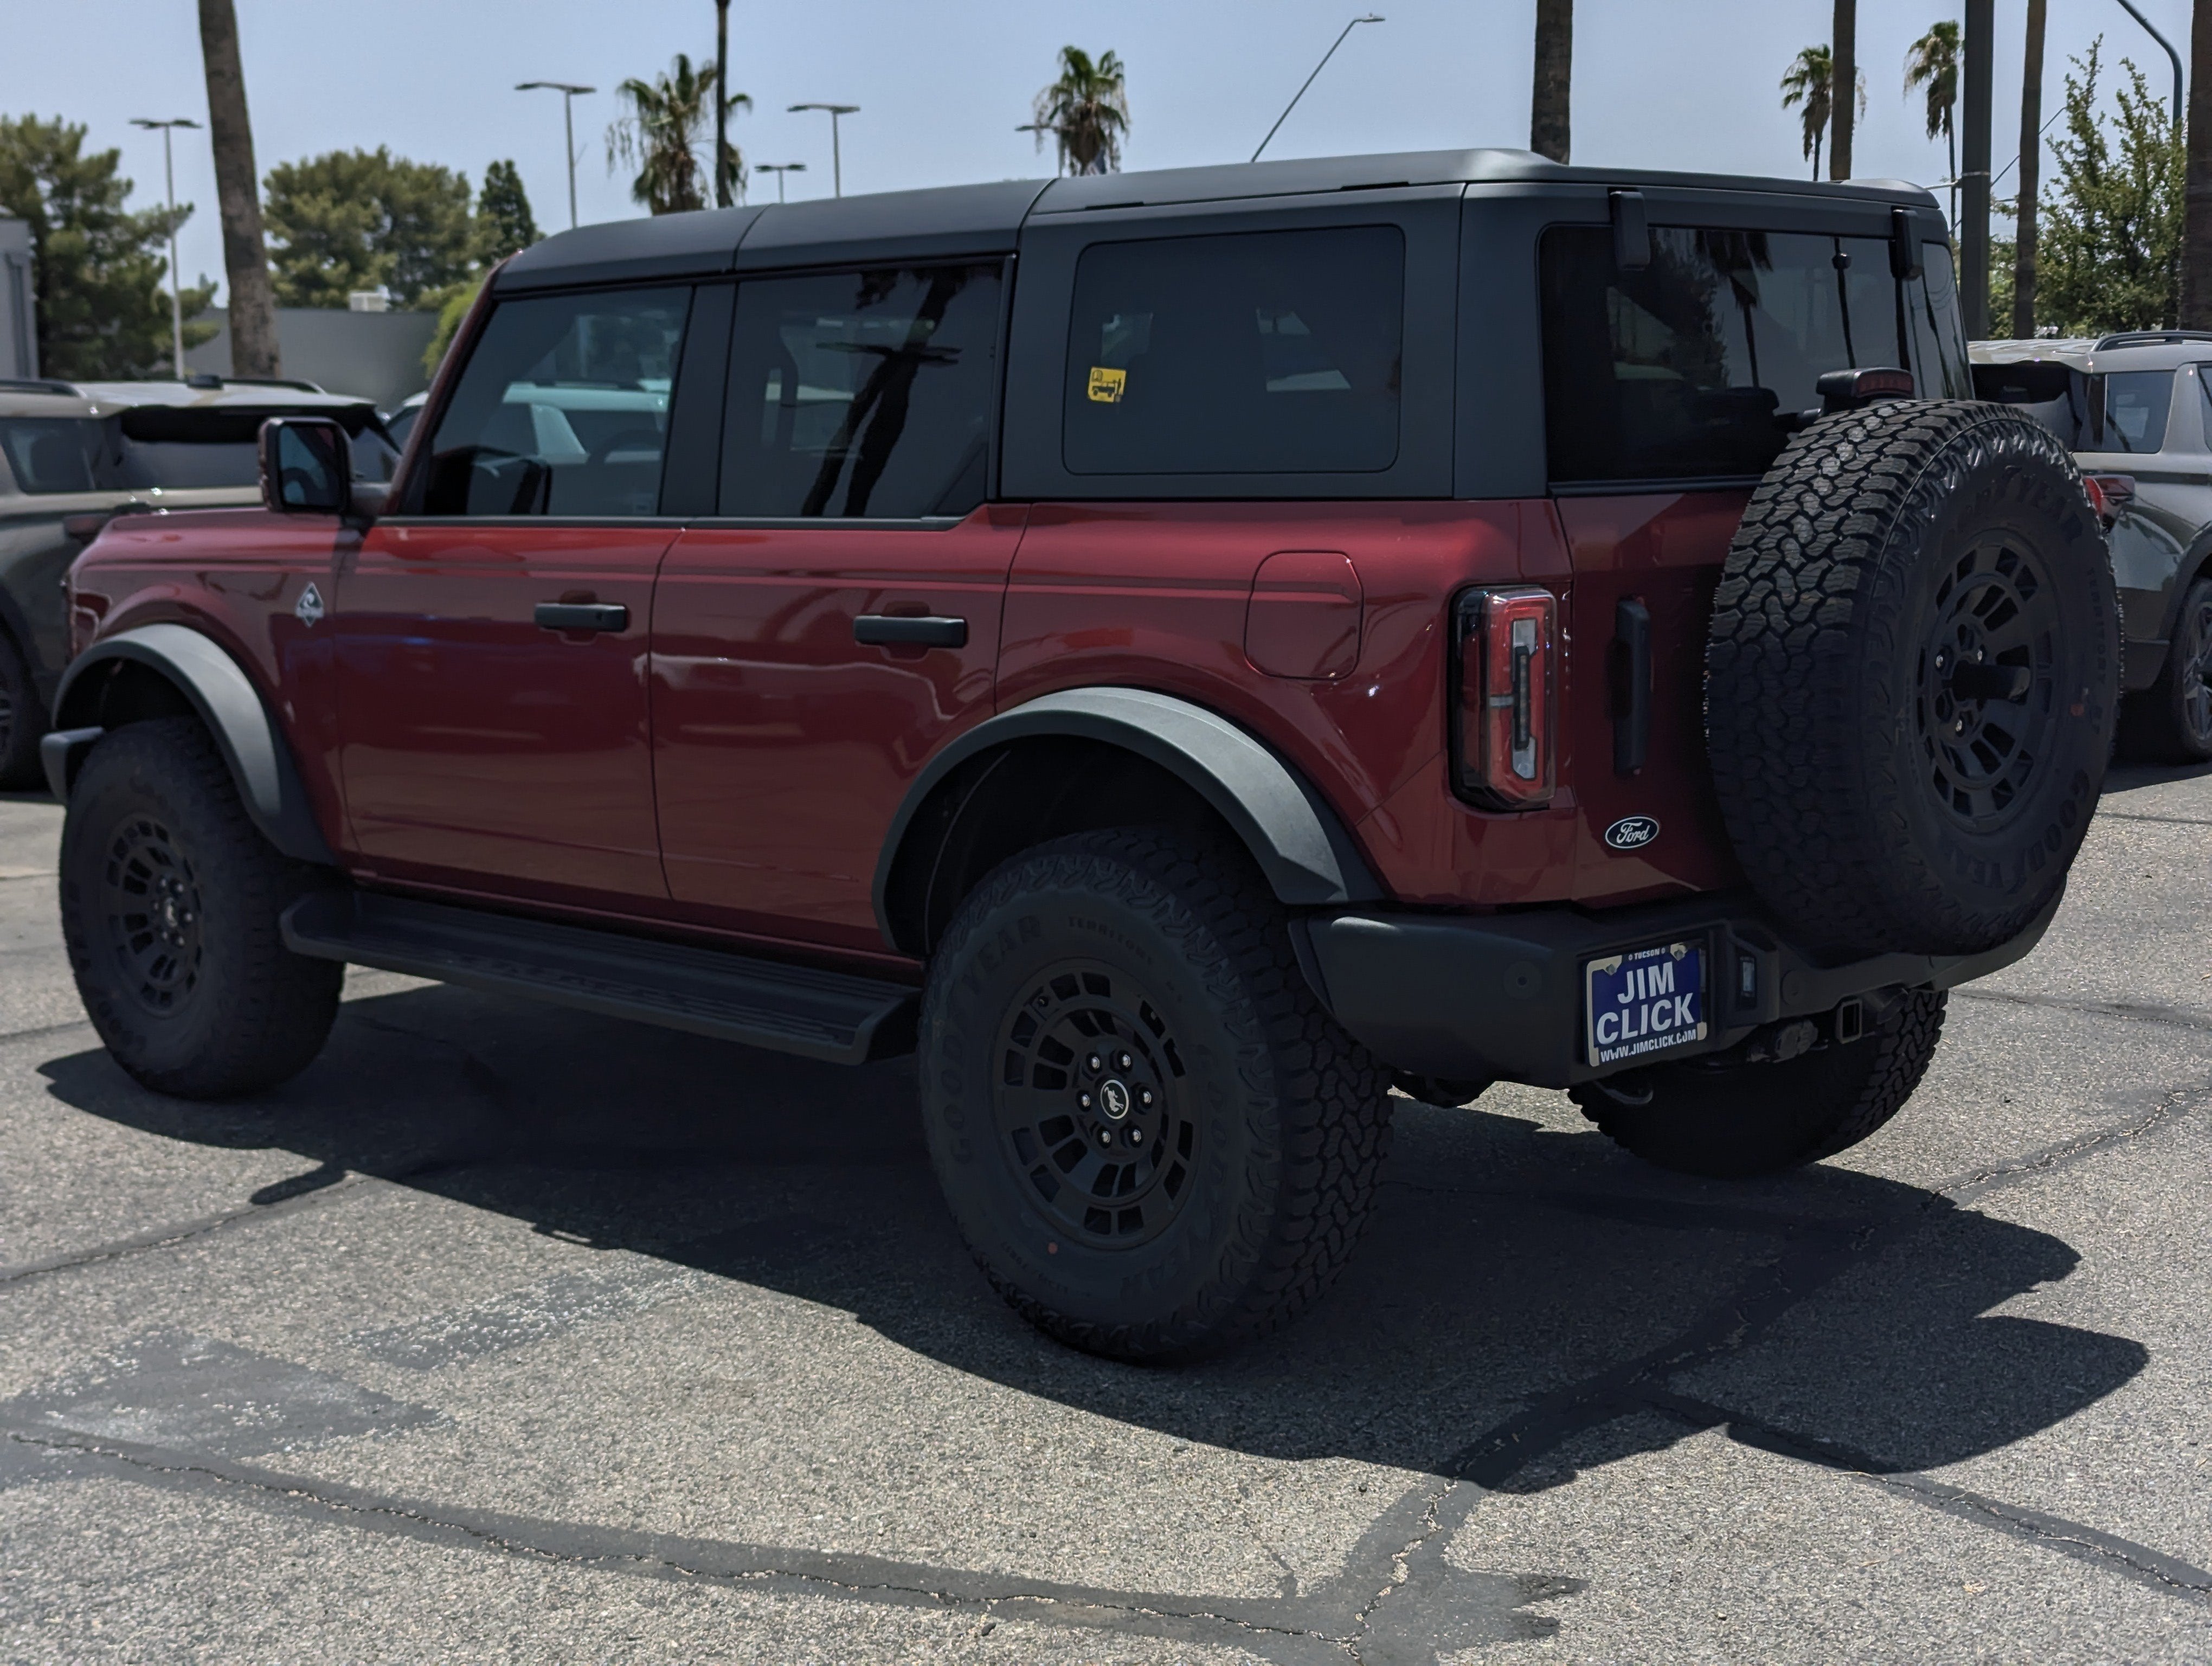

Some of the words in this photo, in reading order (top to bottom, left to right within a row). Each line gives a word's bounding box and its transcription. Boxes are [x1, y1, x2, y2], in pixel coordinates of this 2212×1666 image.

[1616, 822, 1650, 844] Ford
[1634, 948, 1660, 960] TUCSON
[1617, 961, 1675, 1004] JIM
[1596, 992, 1695, 1045] CLICK
[1600, 1029, 1696, 1062] WWW.JIMCLICK.COM
